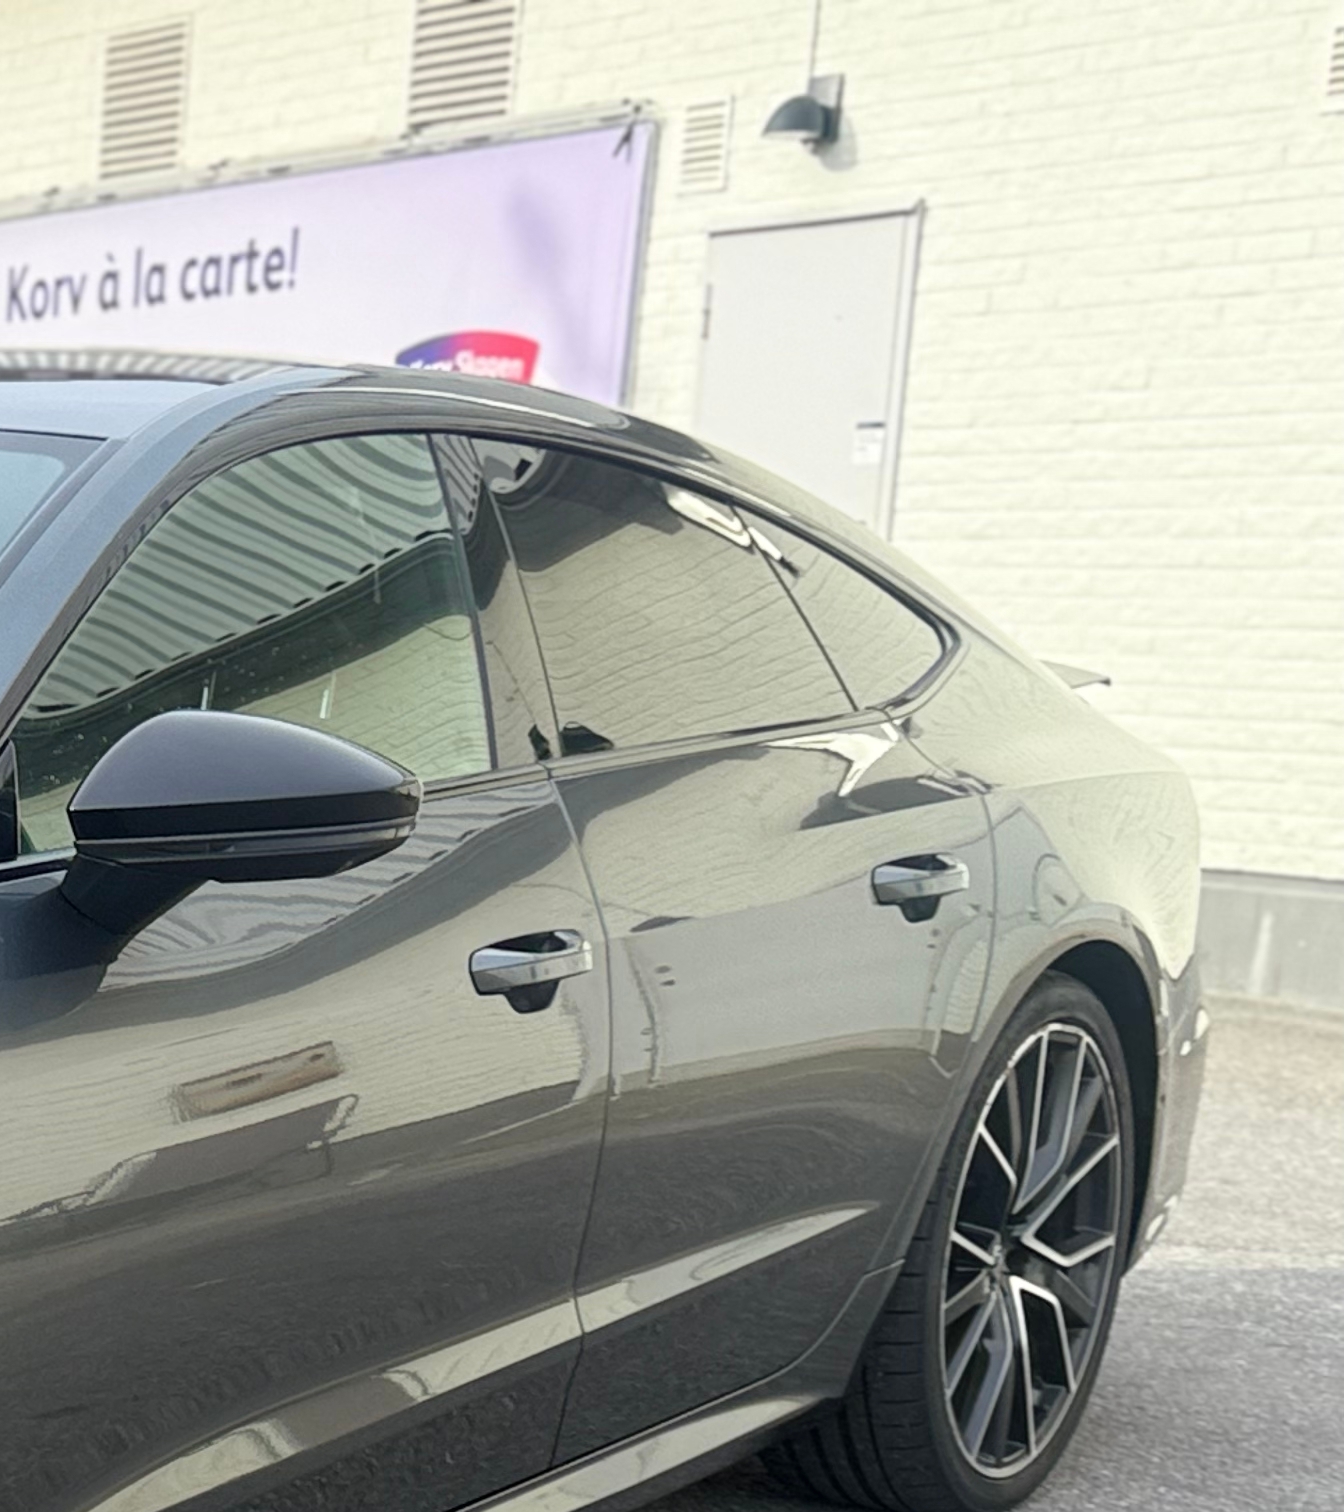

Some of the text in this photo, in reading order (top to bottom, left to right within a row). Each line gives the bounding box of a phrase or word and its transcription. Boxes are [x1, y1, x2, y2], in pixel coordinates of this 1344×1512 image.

[5, 226, 300, 323] Korv à la carte!
